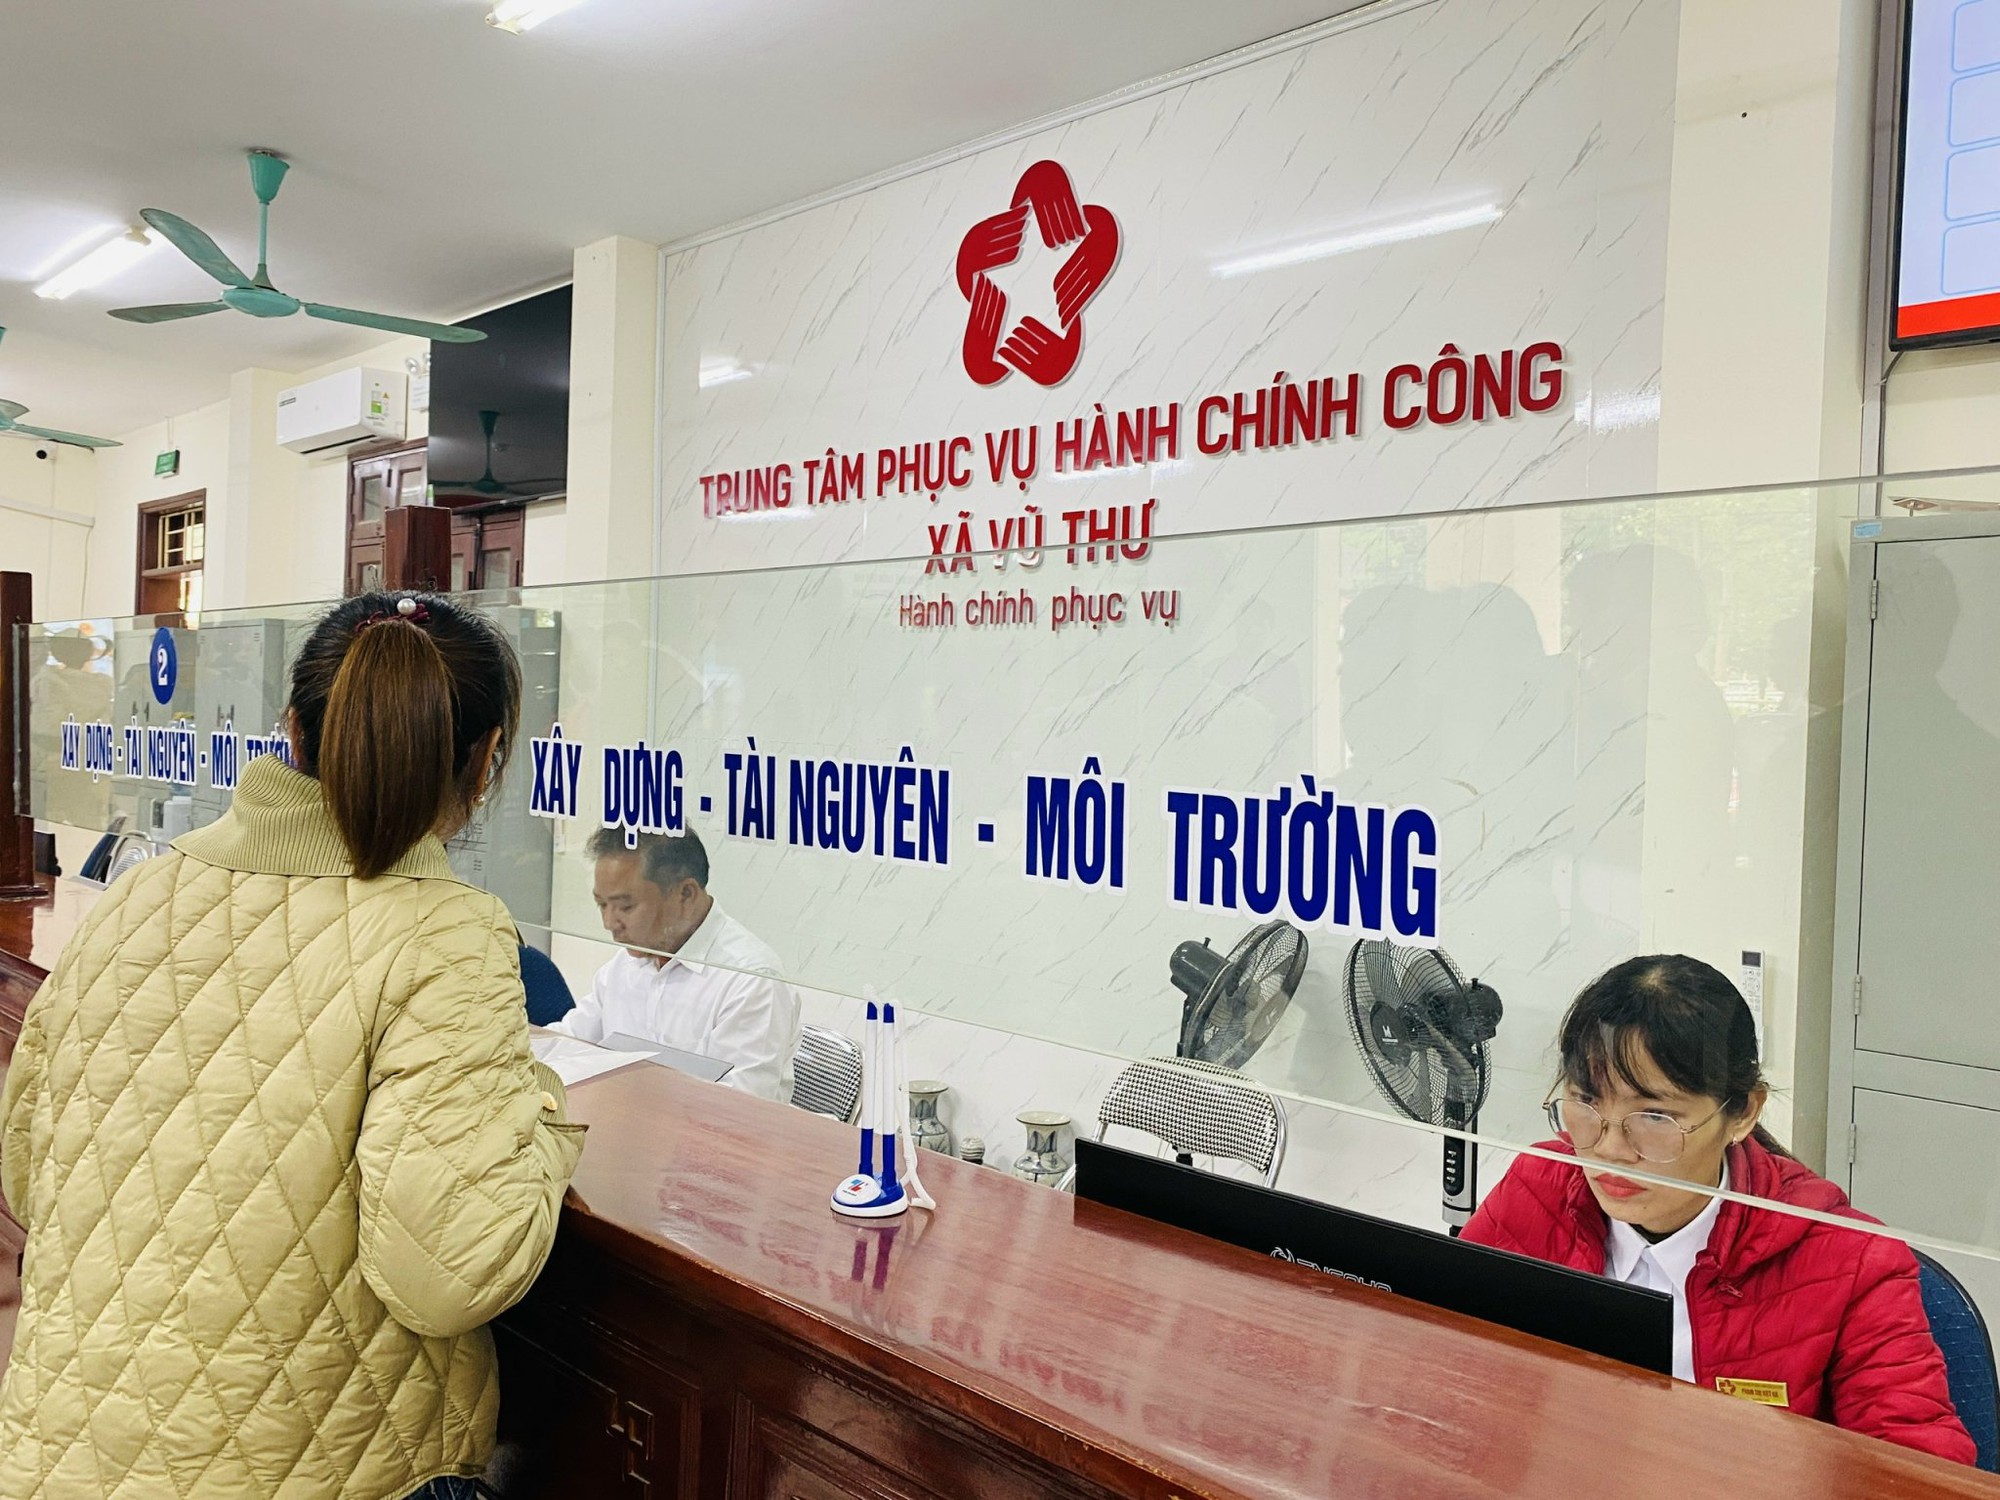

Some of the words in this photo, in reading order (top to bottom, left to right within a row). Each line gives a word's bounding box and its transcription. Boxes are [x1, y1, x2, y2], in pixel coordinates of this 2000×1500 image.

[699, 463, 792, 518] TRUNG
[803, 447, 865, 505] TÂM
[876, 436, 972, 502] PHỤC
[984, 425, 1038, 491] VỤ
[1055, 402, 1179, 474] HÀNH
[1196, 371, 1359, 455] CHÍNH
[1383, 341, 1563, 429] CÔNG
[925, 510, 974, 574] XÃ
[988, 504, 1044, 569] VŨ
[1062, 498, 1157, 564] THƯ
[899, 592, 954, 627] Hành
[965, 588, 1034, 625] chính
[1052, 585, 1123, 631] phục
[1141, 590, 1177, 627] vụ
[158, 647, 168, 686] 2
[62, 715, 80, 769] XÂY
[86, 721, 113, 780] DỰNG
[125, 717, 142, 776] TÀI
[148, 720, 195, 783] NGUYÊN
[212, 723, 237, 788] MÔI
[531, 725, 582, 817] XÂY
[604, 740, 683, 845] DỰNG
[724, 736, 776, 841] TÀI
[789, 746, 950, 865] NGUYÊN
[978, 823, 994, 842] -
[1025, 756, 1125, 889] MÔI
[1167, 774, 1437, 938] TRƯỜNG
